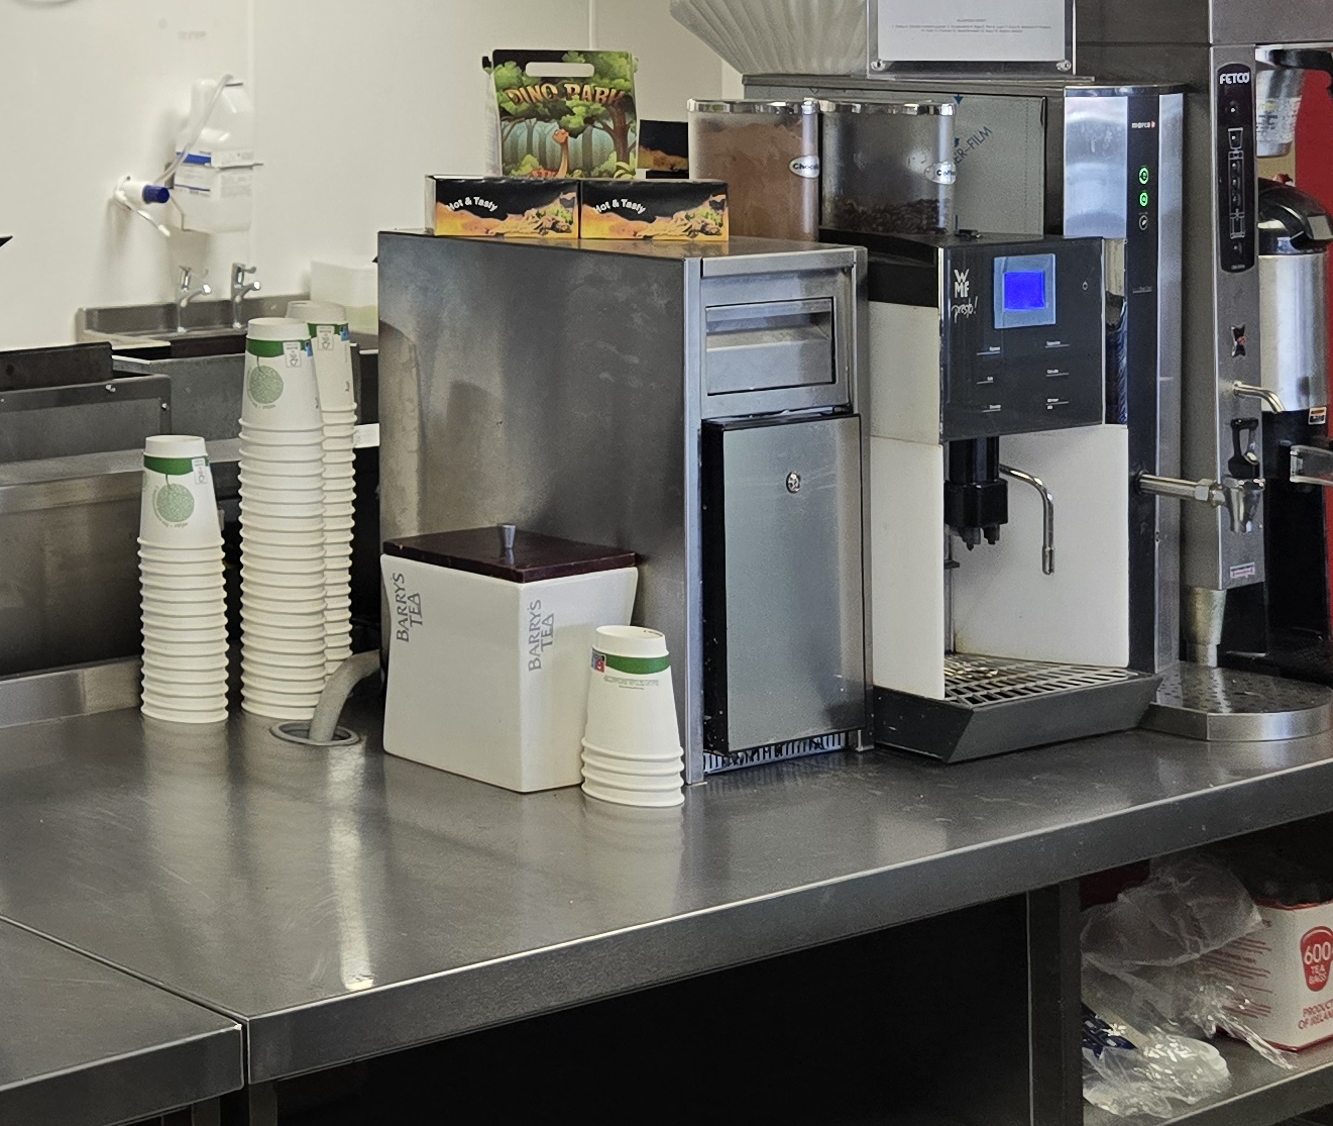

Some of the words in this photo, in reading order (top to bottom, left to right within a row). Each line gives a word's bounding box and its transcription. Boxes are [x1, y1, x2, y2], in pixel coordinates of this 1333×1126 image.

[1219, 72, 1250, 84] FETCO
[504, 82, 558, 105] DINO
[564, 83, 625, 105] PARK
[447, 199, 463, 211] Hot
[465, 197, 472, 205] &
[473, 196, 498, 211] Tasty
[407, 593, 423, 627] TEA
[1304, 941, 1331, 965] 600
[1311, 964, 1325, 974] TEA
